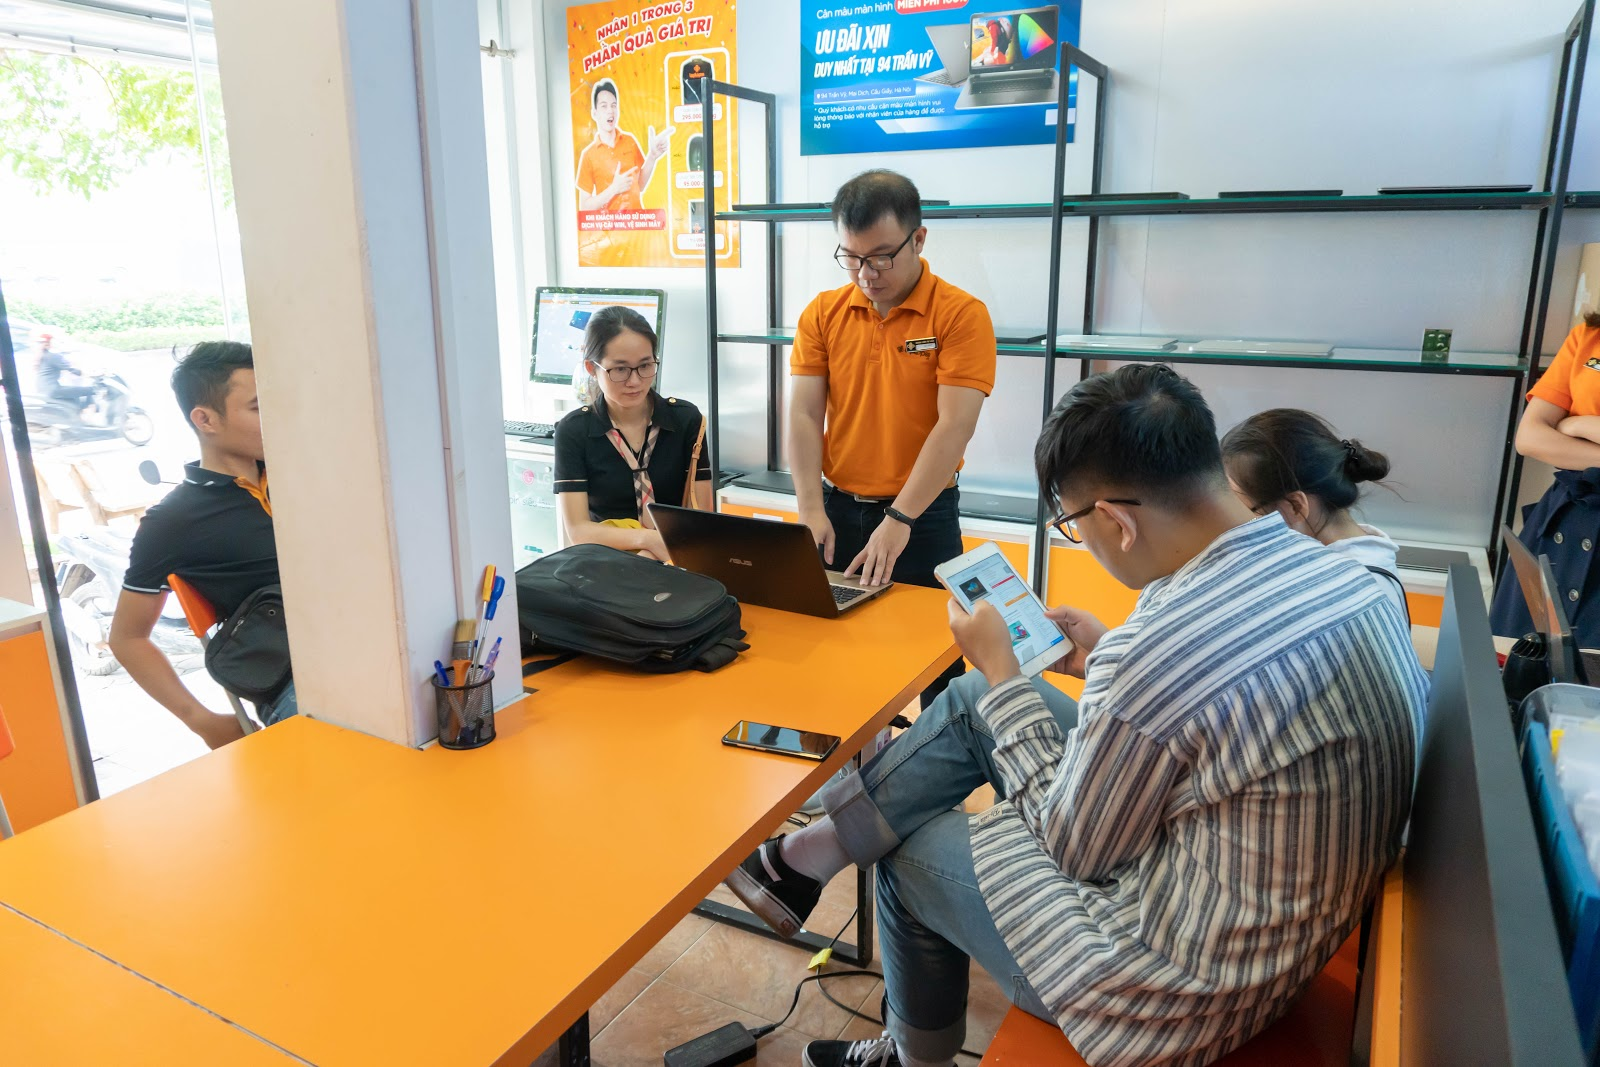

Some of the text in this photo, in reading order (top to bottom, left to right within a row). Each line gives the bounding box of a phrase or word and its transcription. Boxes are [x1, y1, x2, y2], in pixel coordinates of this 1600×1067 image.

[597, 1, 693, 40] NHẬN 1 TRONG 3
[817, 9, 833, 19] Cân
[835, 6, 853, 16] màu
[854, 4, 873, 14] màn
[875, 2, 893, 12] hình
[584, 17, 712, 72] PHẦN QUÀ GIÁ TRỊ
[815, 23, 891, 54] ƯU ĐÃI XỊN
[814, 60, 834, 78] DUY
[833, 55, 860, 76] NHẤT
[860, 56, 875, 76] TẠI
[877, 56, 890, 72] 94
[729, 558, 752, 566] ASUS
